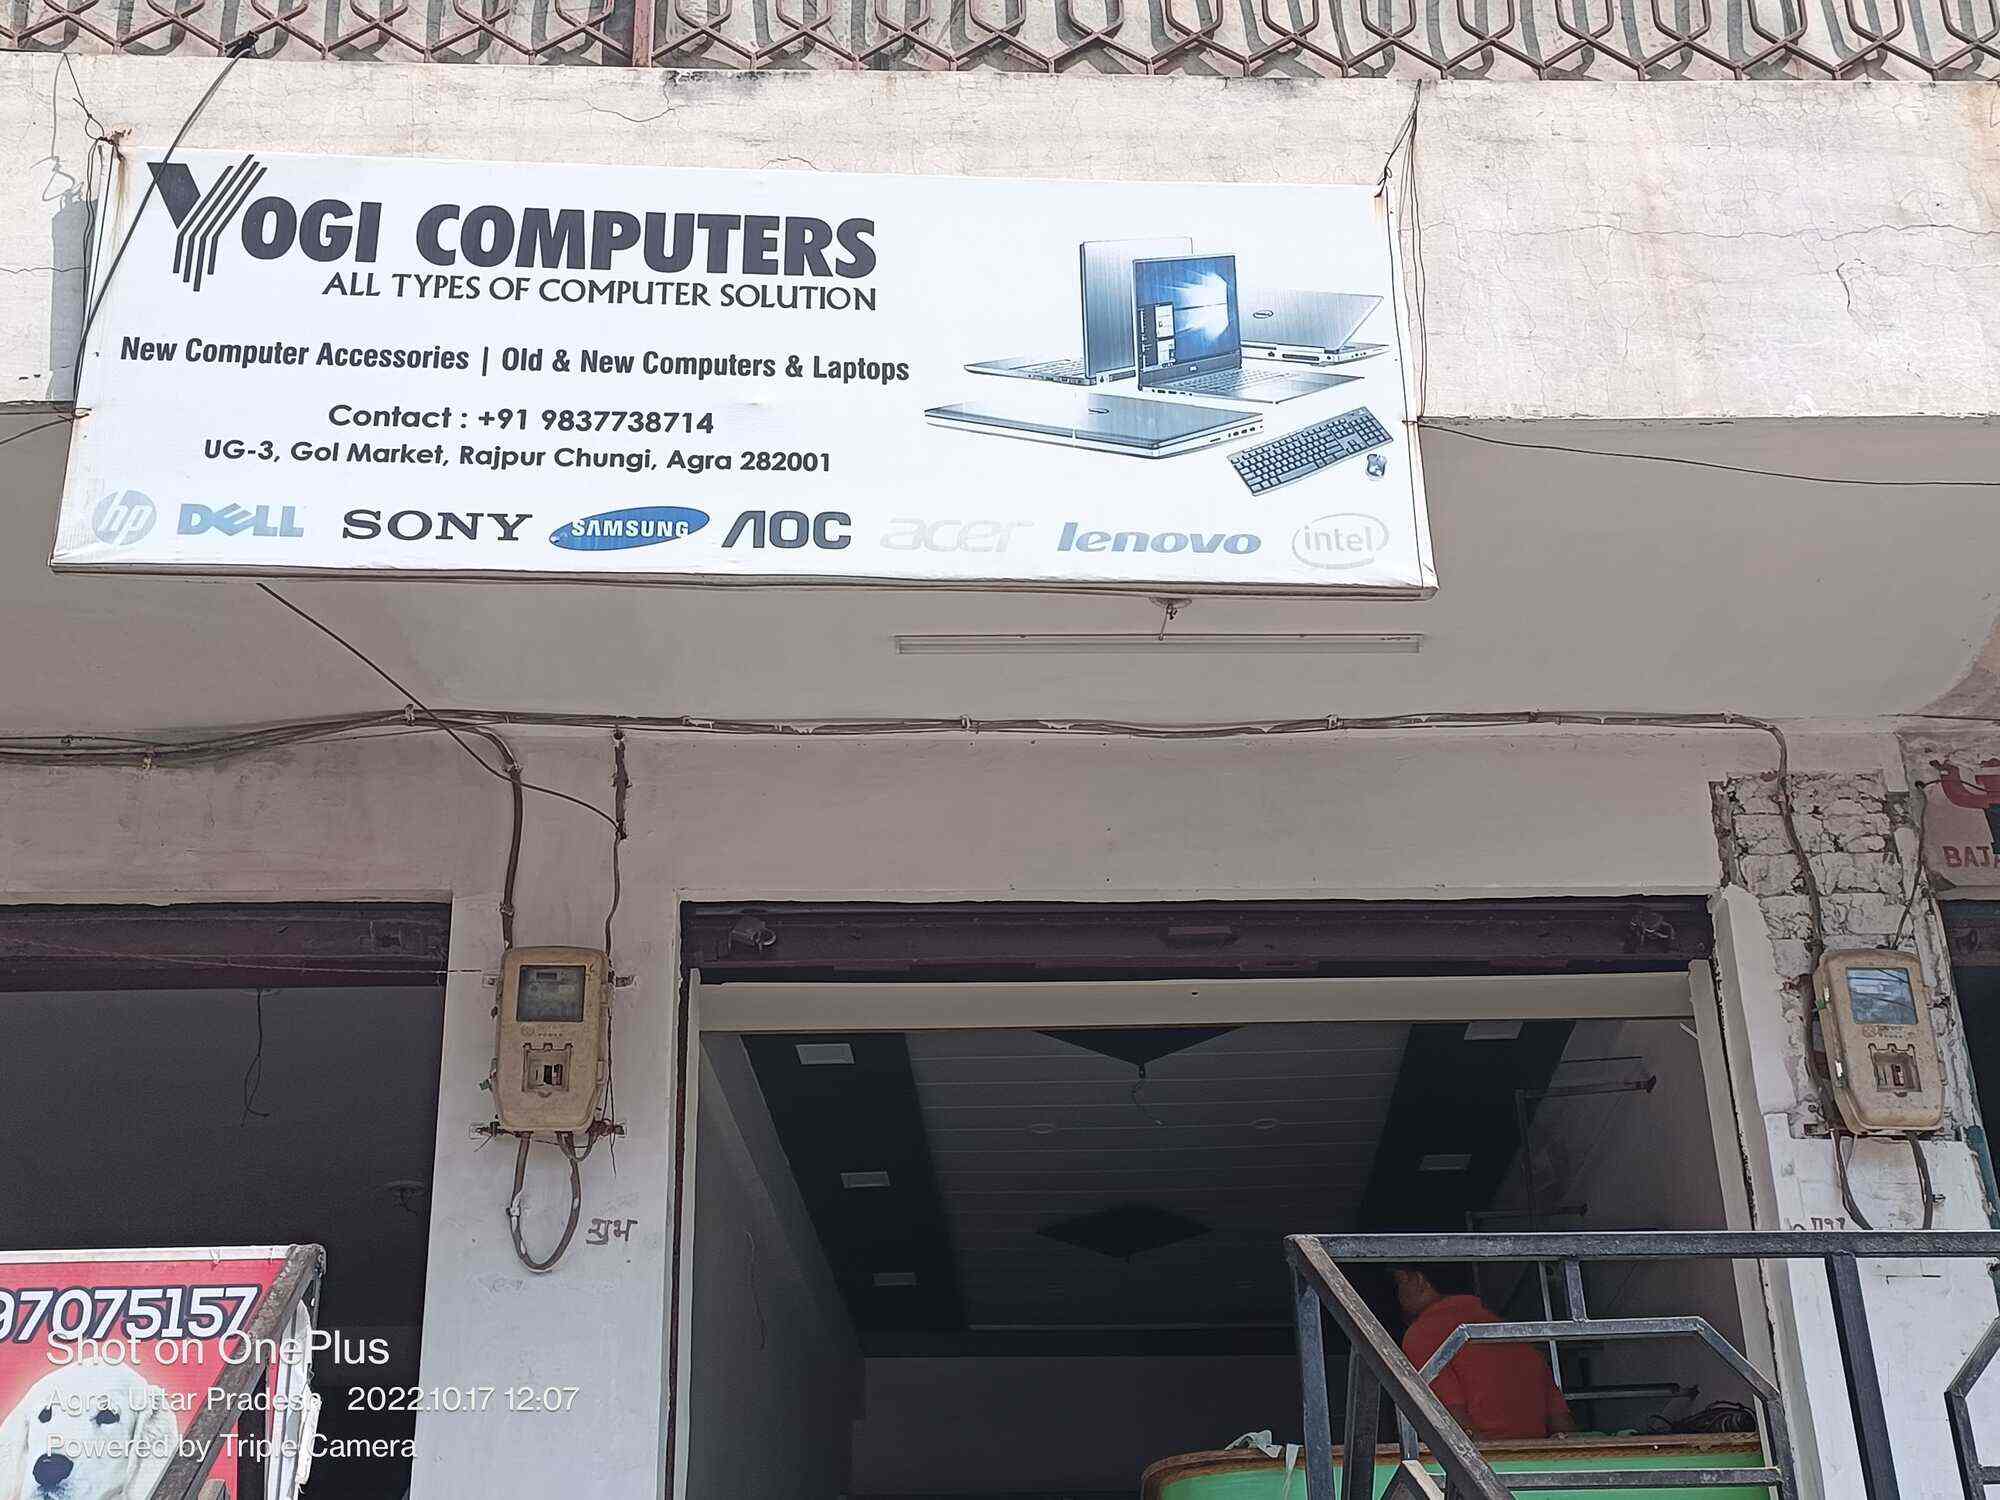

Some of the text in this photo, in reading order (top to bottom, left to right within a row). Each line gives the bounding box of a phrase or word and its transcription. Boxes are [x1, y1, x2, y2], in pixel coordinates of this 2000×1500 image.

[147, 154, 877, 291] YOGI COMPUTERS
[321, 271, 876, 311] ALL TYPES OF COMPUTER SOLUTION
[120, 336, 178, 362] New
[185, 337, 310, 369] Computer
[315, 342, 470, 370] Accessories
[501, 346, 543, 372] Old
[552, 348, 571, 373] &
[580, 349, 635, 374] New
[642, 350, 776, 381] Computers
[784, 354, 804, 378] &
[813, 355, 910, 386] Laptops
[328, 404, 452, 429] Contact
[478, 408, 527, 430] +91
[541, 409, 714, 434] 9837738714
[204, 439, 830, 475] UG-3, Gol Market, Rajpur Chungi, Agra 282001
[97, 487, 1374, 555] hp DELL SONY SAMSUNG AOC acer lenovo intel
